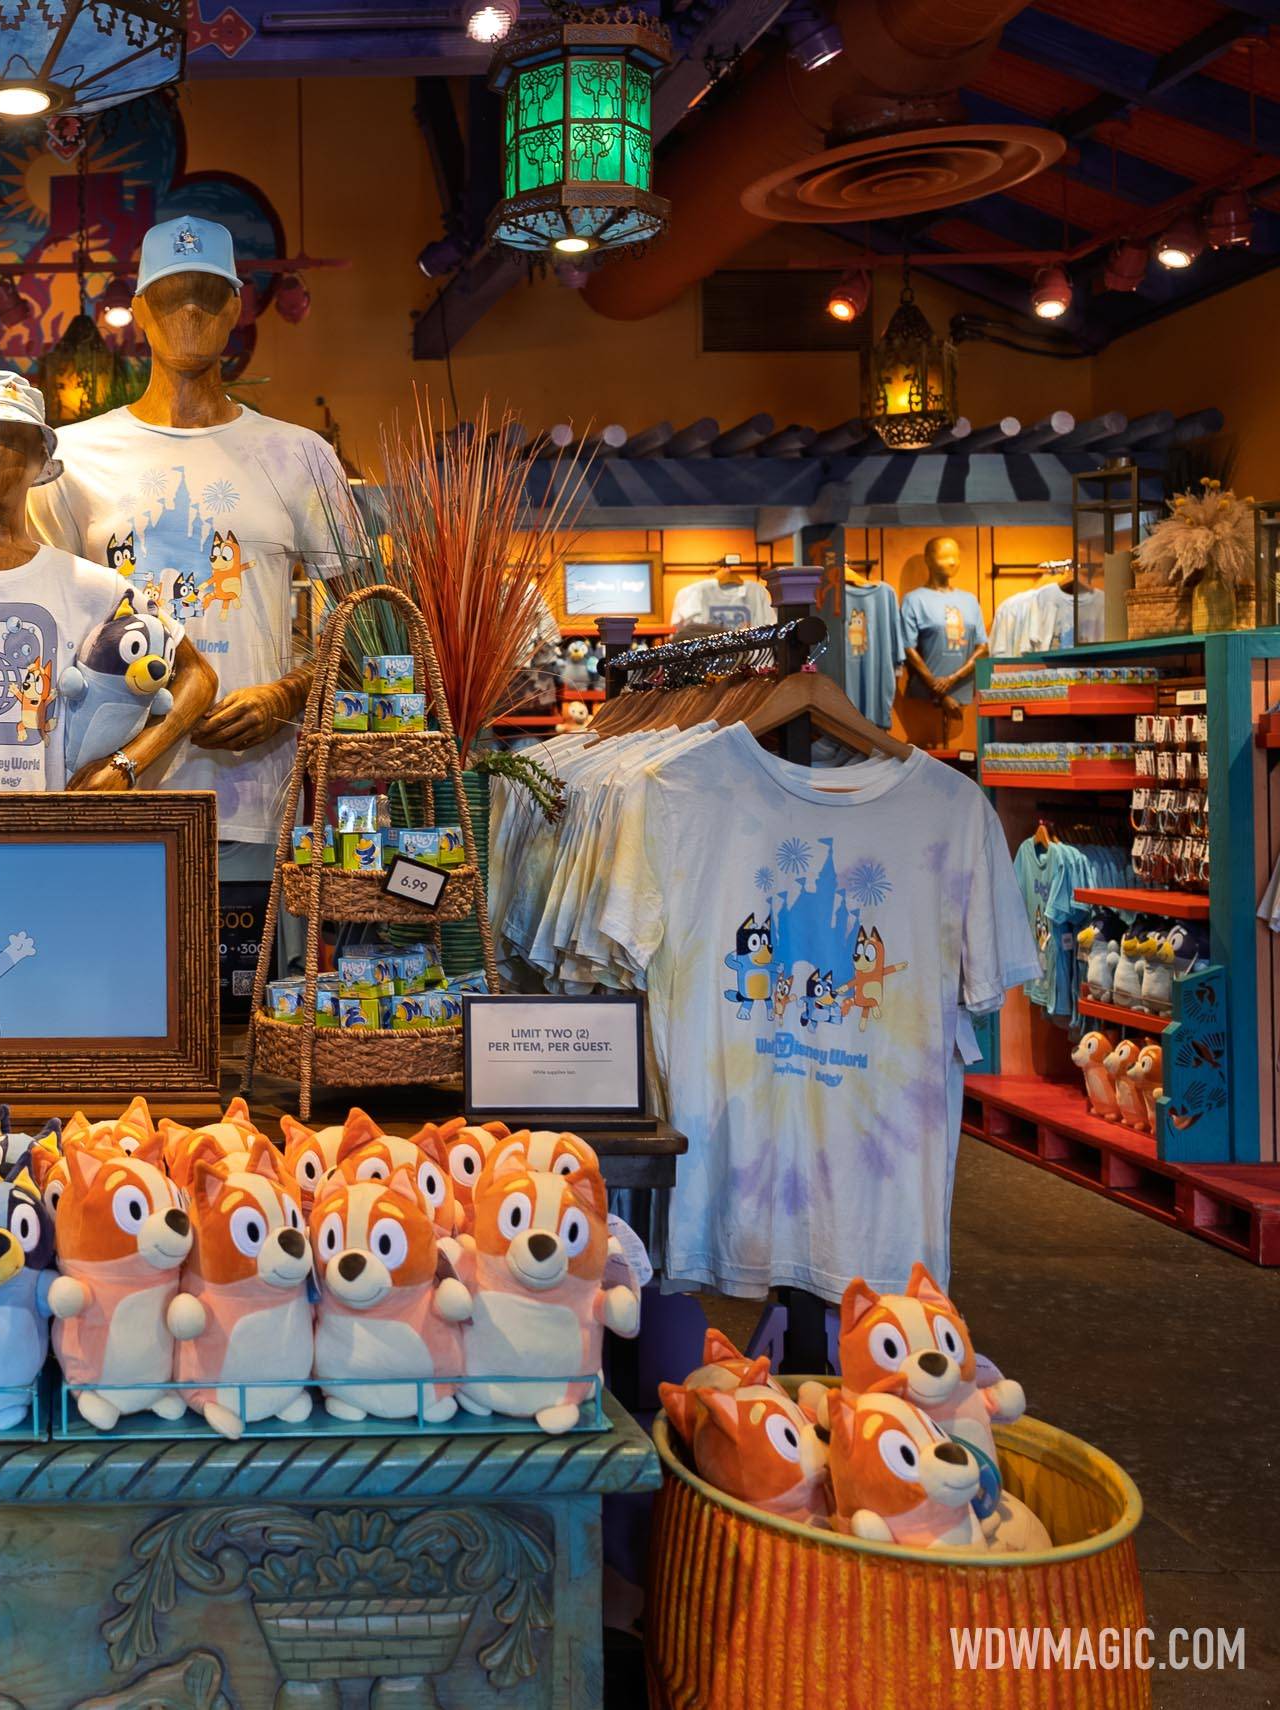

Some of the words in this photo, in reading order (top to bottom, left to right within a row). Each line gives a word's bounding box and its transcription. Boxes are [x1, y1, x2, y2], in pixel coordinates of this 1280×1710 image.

[196, 639, 229, 653] World
[400, 875, 428, 893] 6.99
[511, 1028, 541, 1039] LIMIT
[544, 1028, 573, 1039] TWO
[576, 1028, 590, 1040] (2)
[488, 1041, 510, 1052] PER
[513, 1041, 544, 1053] ITEM,
[548, 1041, 570, 1052] PER
[573, 1041, 613, 1052] GUEST.
[829, 1048, 868, 1069] World
